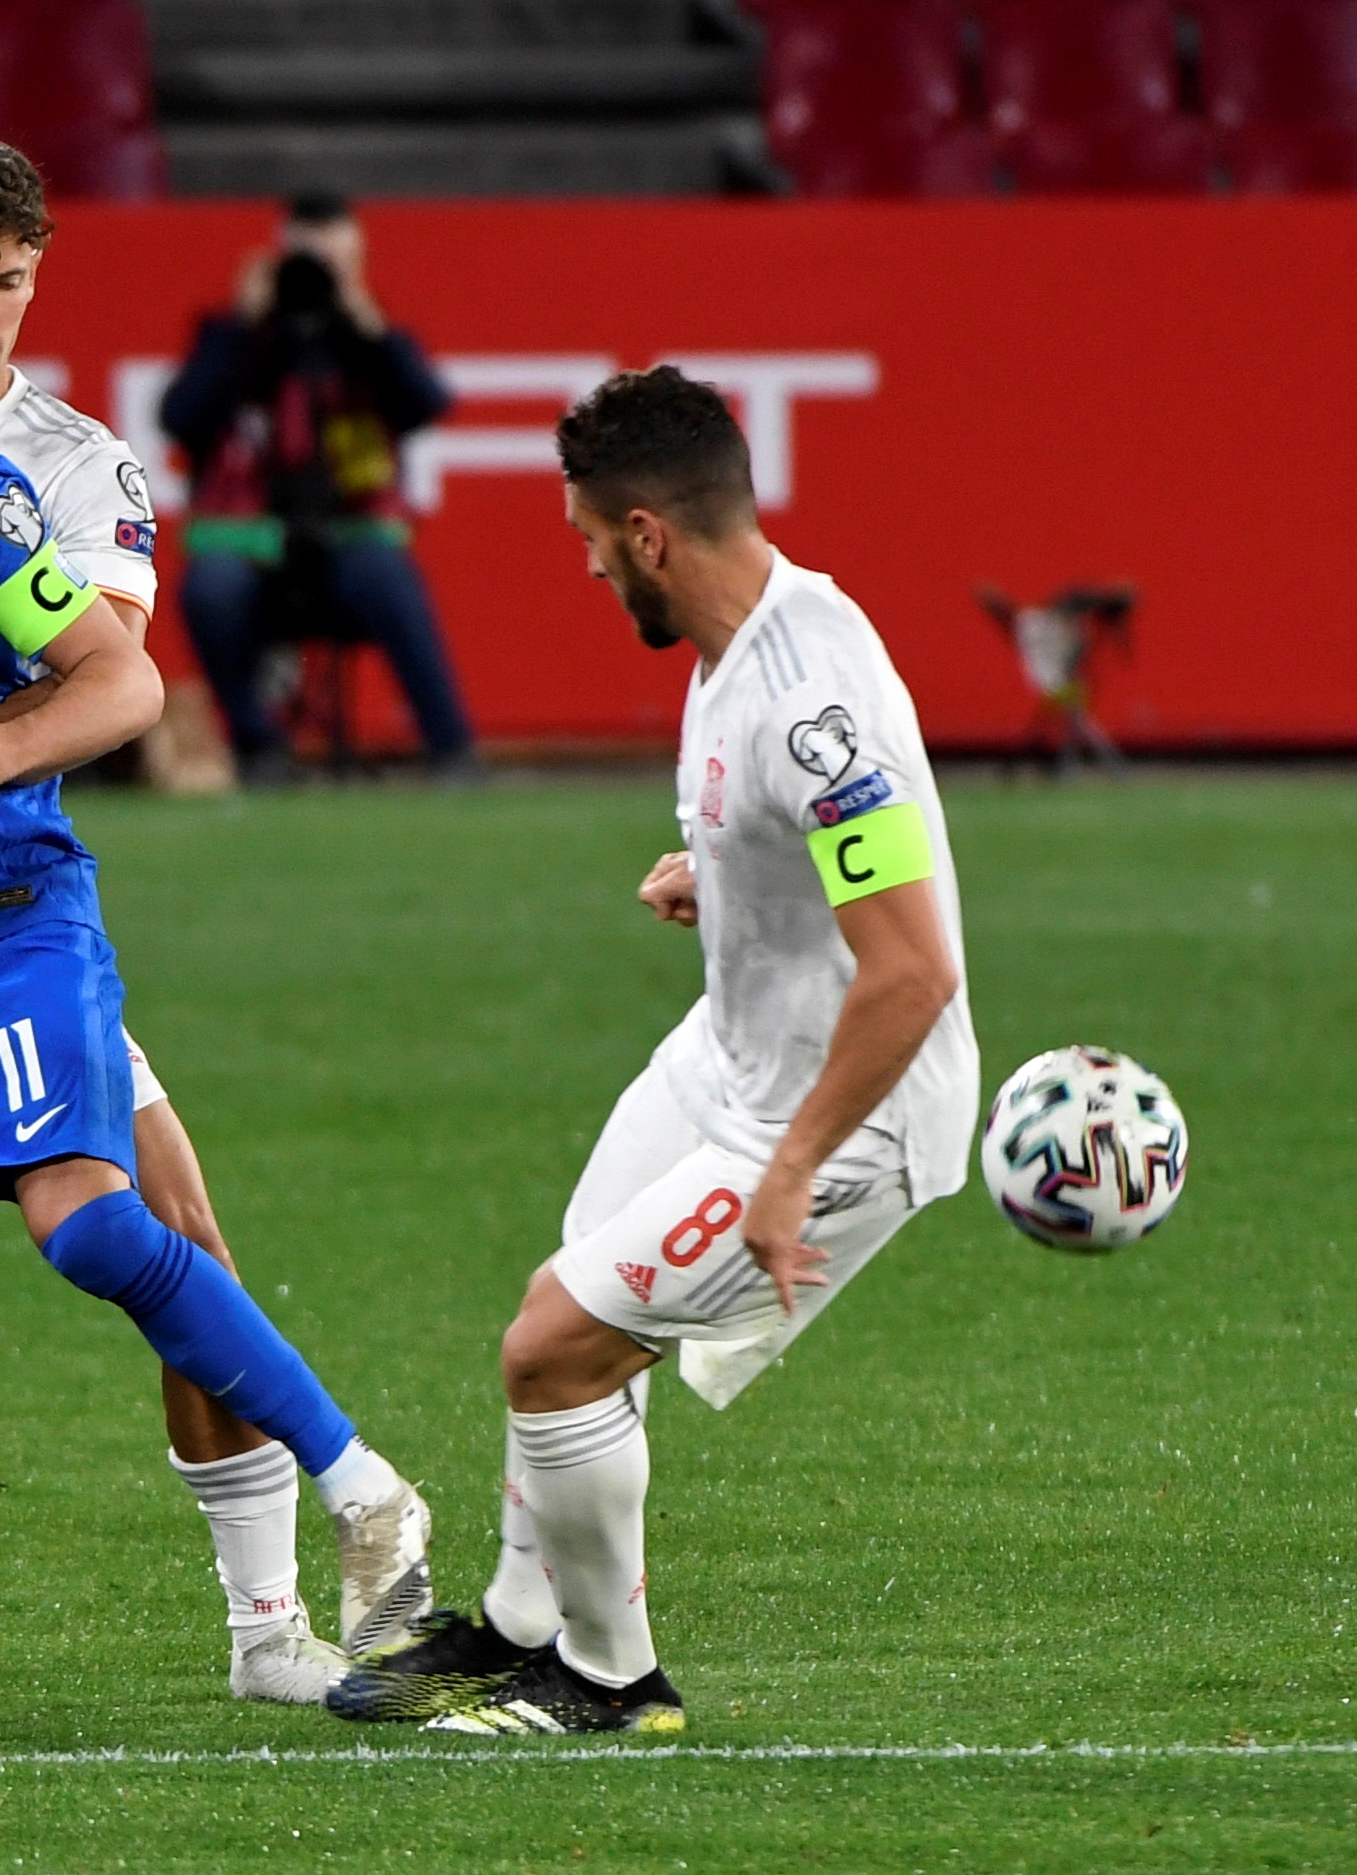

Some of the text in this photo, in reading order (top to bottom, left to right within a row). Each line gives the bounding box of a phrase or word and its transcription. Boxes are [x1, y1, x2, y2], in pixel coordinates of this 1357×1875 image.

[30, 566, 74, 612] C
[837, 834, 876, 884] C
[660, 1187, 743, 1268] 8
